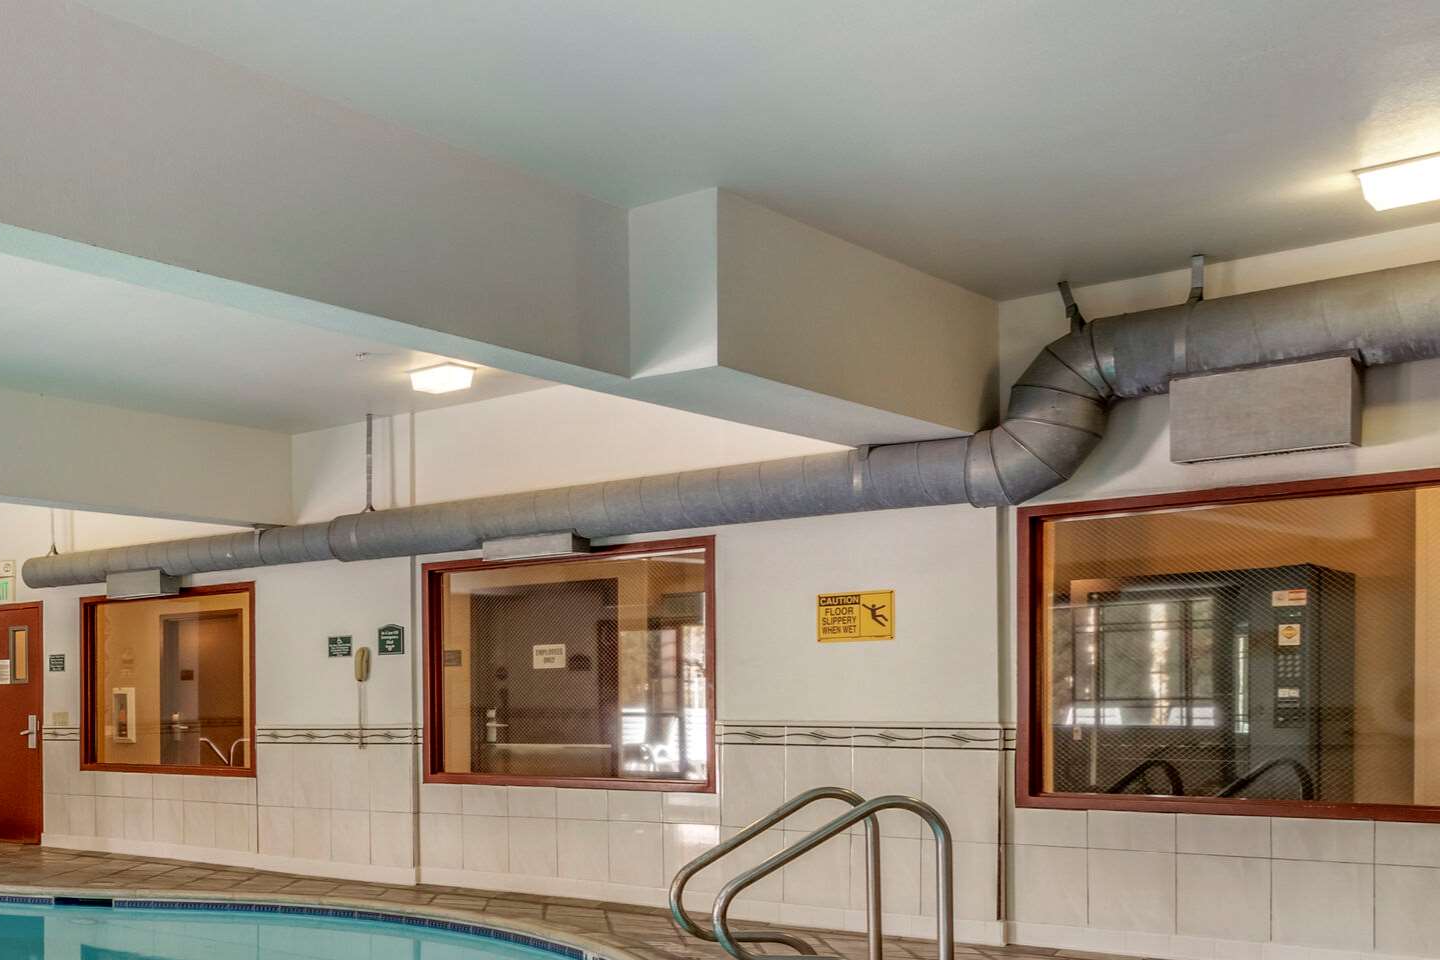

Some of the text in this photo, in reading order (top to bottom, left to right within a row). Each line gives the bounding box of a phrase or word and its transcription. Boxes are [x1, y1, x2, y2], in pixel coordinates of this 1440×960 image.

[820, 595, 859, 606] CAUTION
[825, 606, 854, 616] FLOOR
[822, 616, 857, 625] SLIPPERY
[822, 625, 857, 634] WHEN WET
